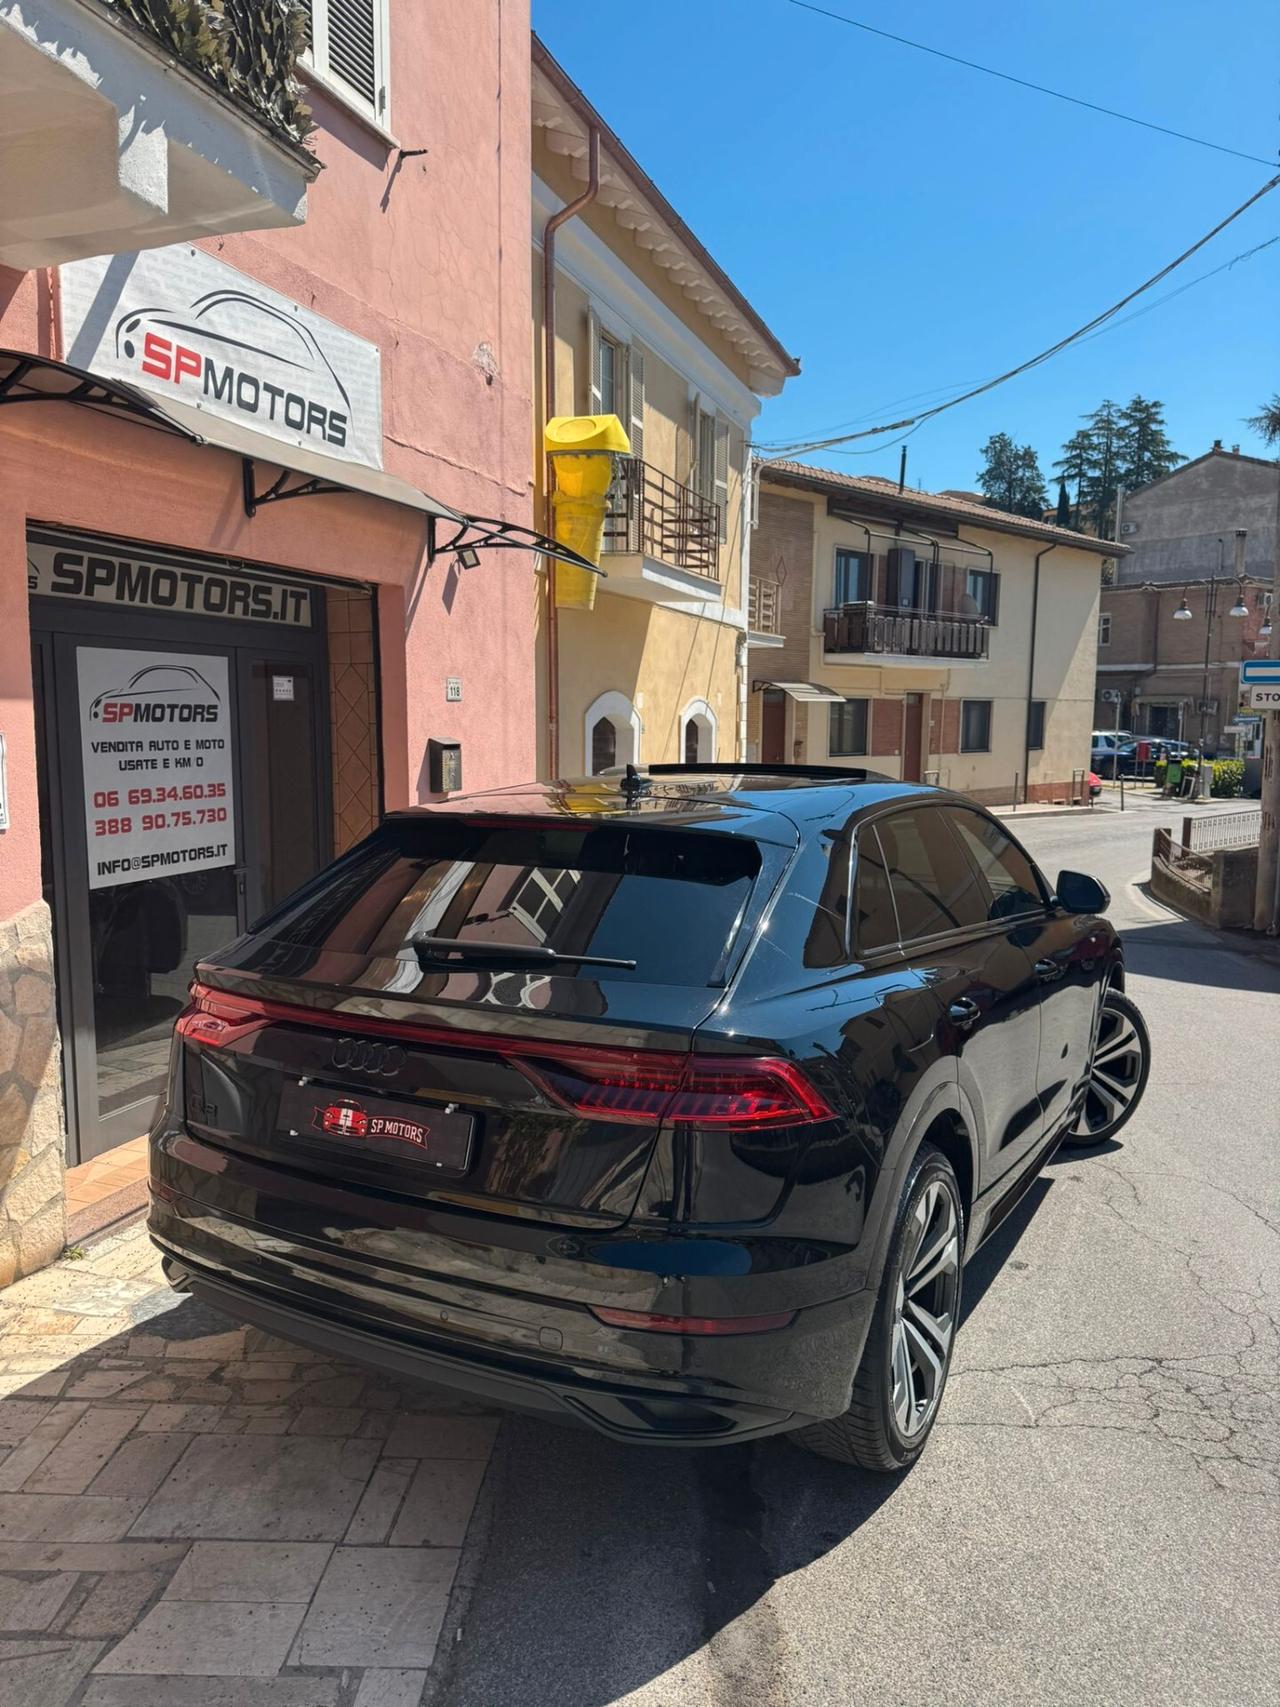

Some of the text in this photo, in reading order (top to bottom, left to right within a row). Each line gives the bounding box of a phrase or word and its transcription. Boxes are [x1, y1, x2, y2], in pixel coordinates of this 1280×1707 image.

[142, 331, 348, 448] SPMOTORS
[51, 551, 307, 623] SPMOTORS.IT
[102, 703, 219, 723] SPMOTORS
[91, 739, 225, 753] VENDITA AUTO E MOTO
[119, 759, 158, 771] USATE
[163, 758, 170, 768] E
[175, 757, 192, 768] KM
[94, 783, 227, 808] 06 69.34.60.35
[95, 807, 228, 836] 388 90.75.730
[97, 844, 229, 876] INFO@SPMOTORS.IT
[370, 1119, 423, 1143] SP MOTORS
